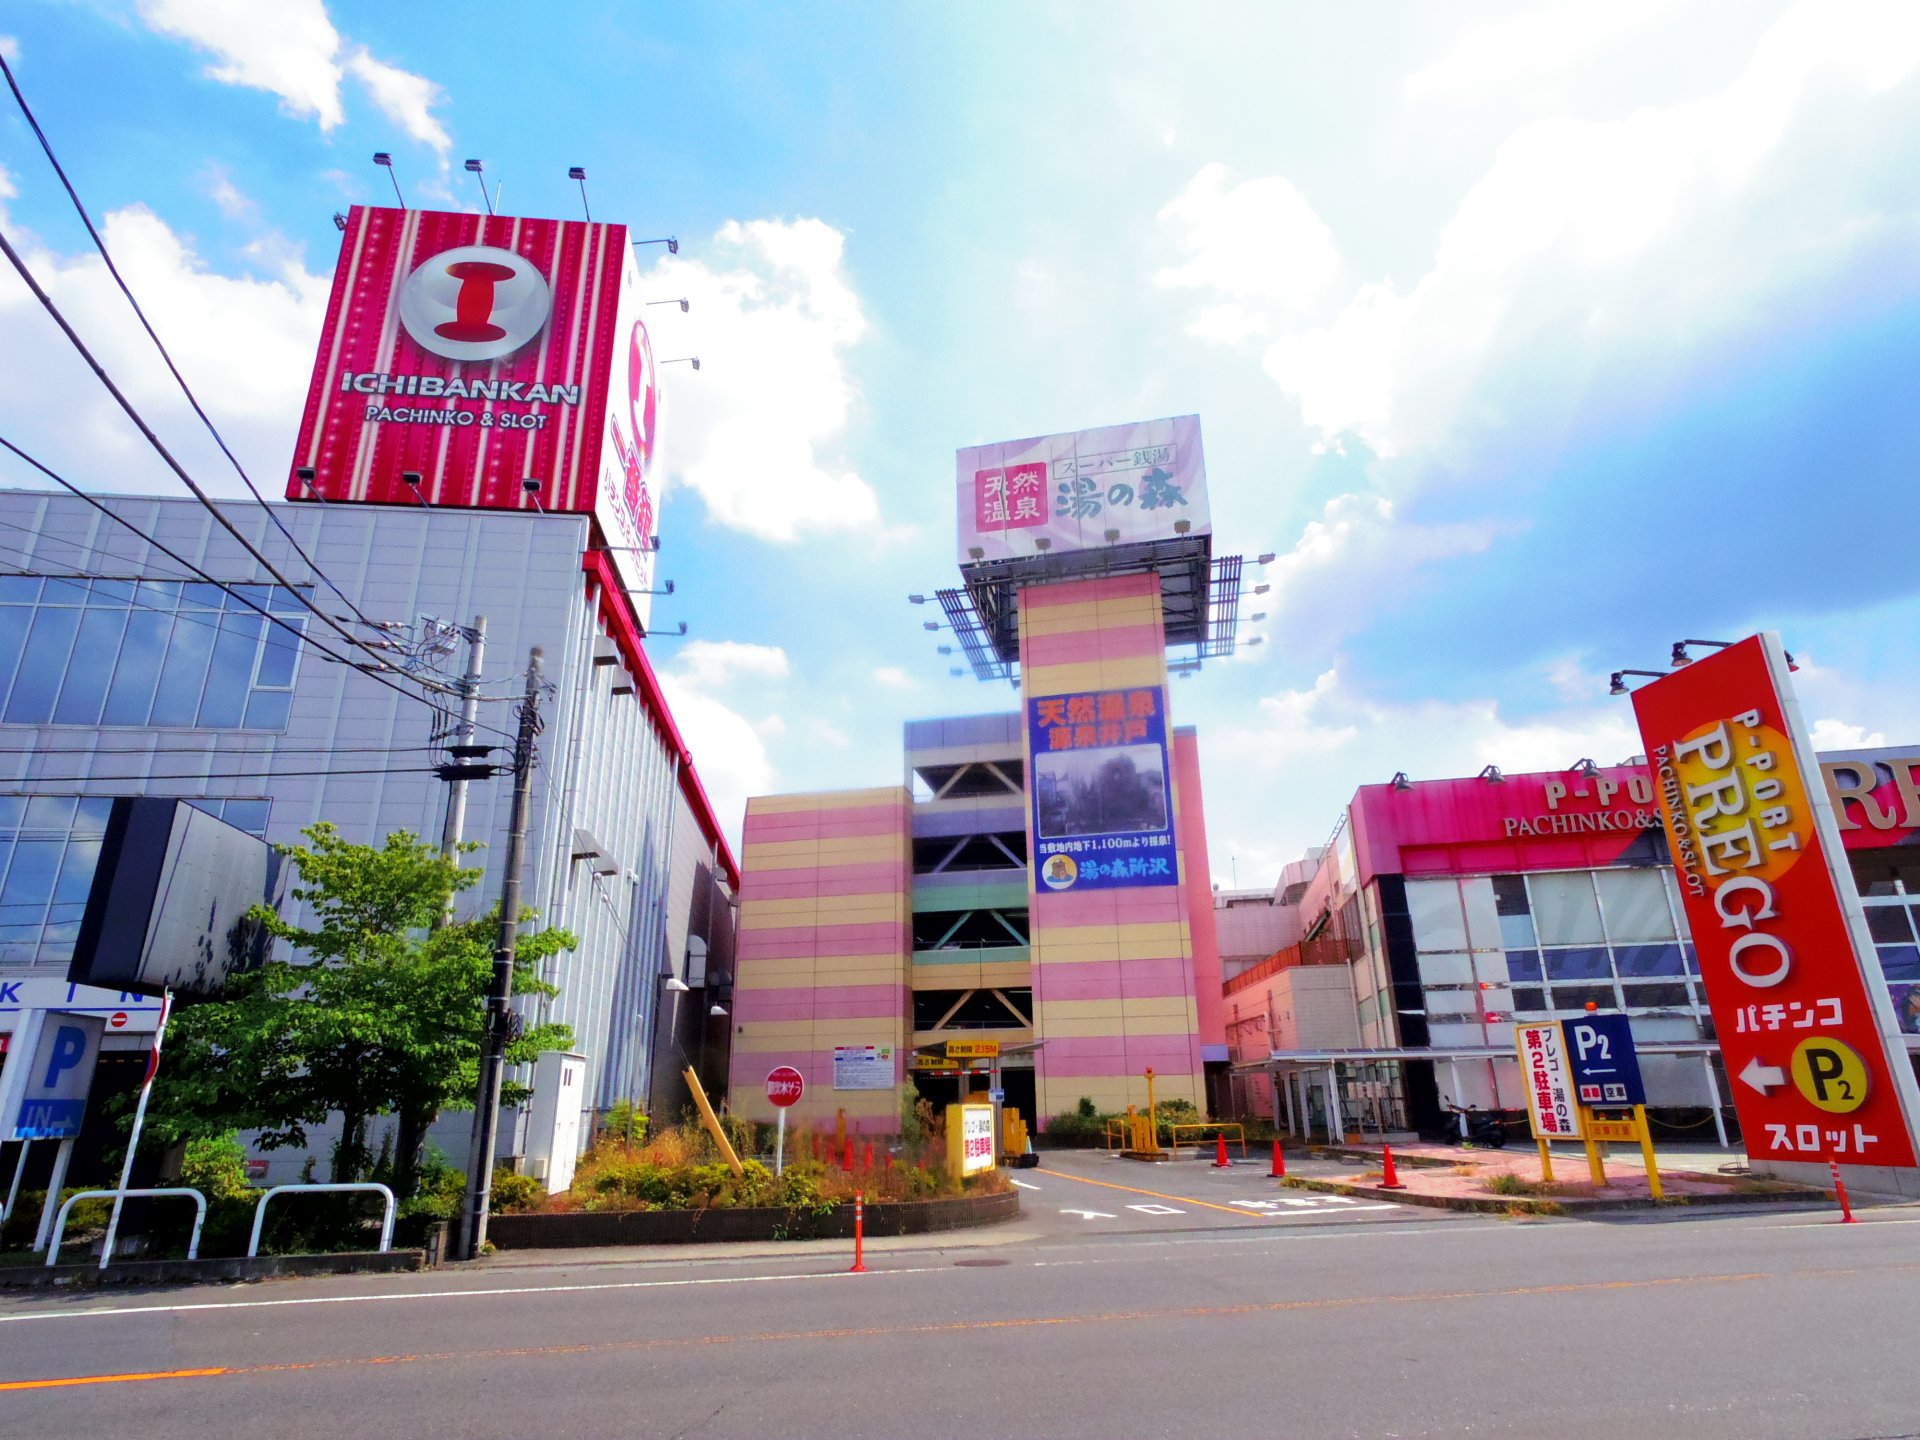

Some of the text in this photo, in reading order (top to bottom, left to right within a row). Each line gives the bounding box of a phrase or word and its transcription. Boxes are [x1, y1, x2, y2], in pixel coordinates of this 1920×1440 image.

[340, 372, 580, 405] ICHIBANKAN
[365, 405, 547, 429] PACHINKO & SLOT
[1062, 446, 1170, 475] スーパー銭湯
[984, 470, 1039, 498] 天然
[1056, 467, 1188, 519] 湯の森
[983, 496, 1040, 524] 温泉
[1038, 690, 1156, 727] 天然温泉
[1732, 708, 1800, 851] P-PORT
[1653, 744, 1705, 897] PACHINKO&SLOT
[1080, 856, 1171, 880] 湯の森所沢
[1672, 720, 1792, 988] PREGO
[1736, 997, 1844, 1033] パチンコ
[44, 1025, 86, 1088] P
[1574, 1024, 1612, 1061] P2
[1525, 1029, 1558, 1133] 第2駐車場
[1542, 1028, 1572, 1133] プレゴ・湯の森
[1805, 1047, 1855, 1101] P2
[26, 1105, 53, 1130] IN
[1764, 1123, 1878, 1153] スロット
